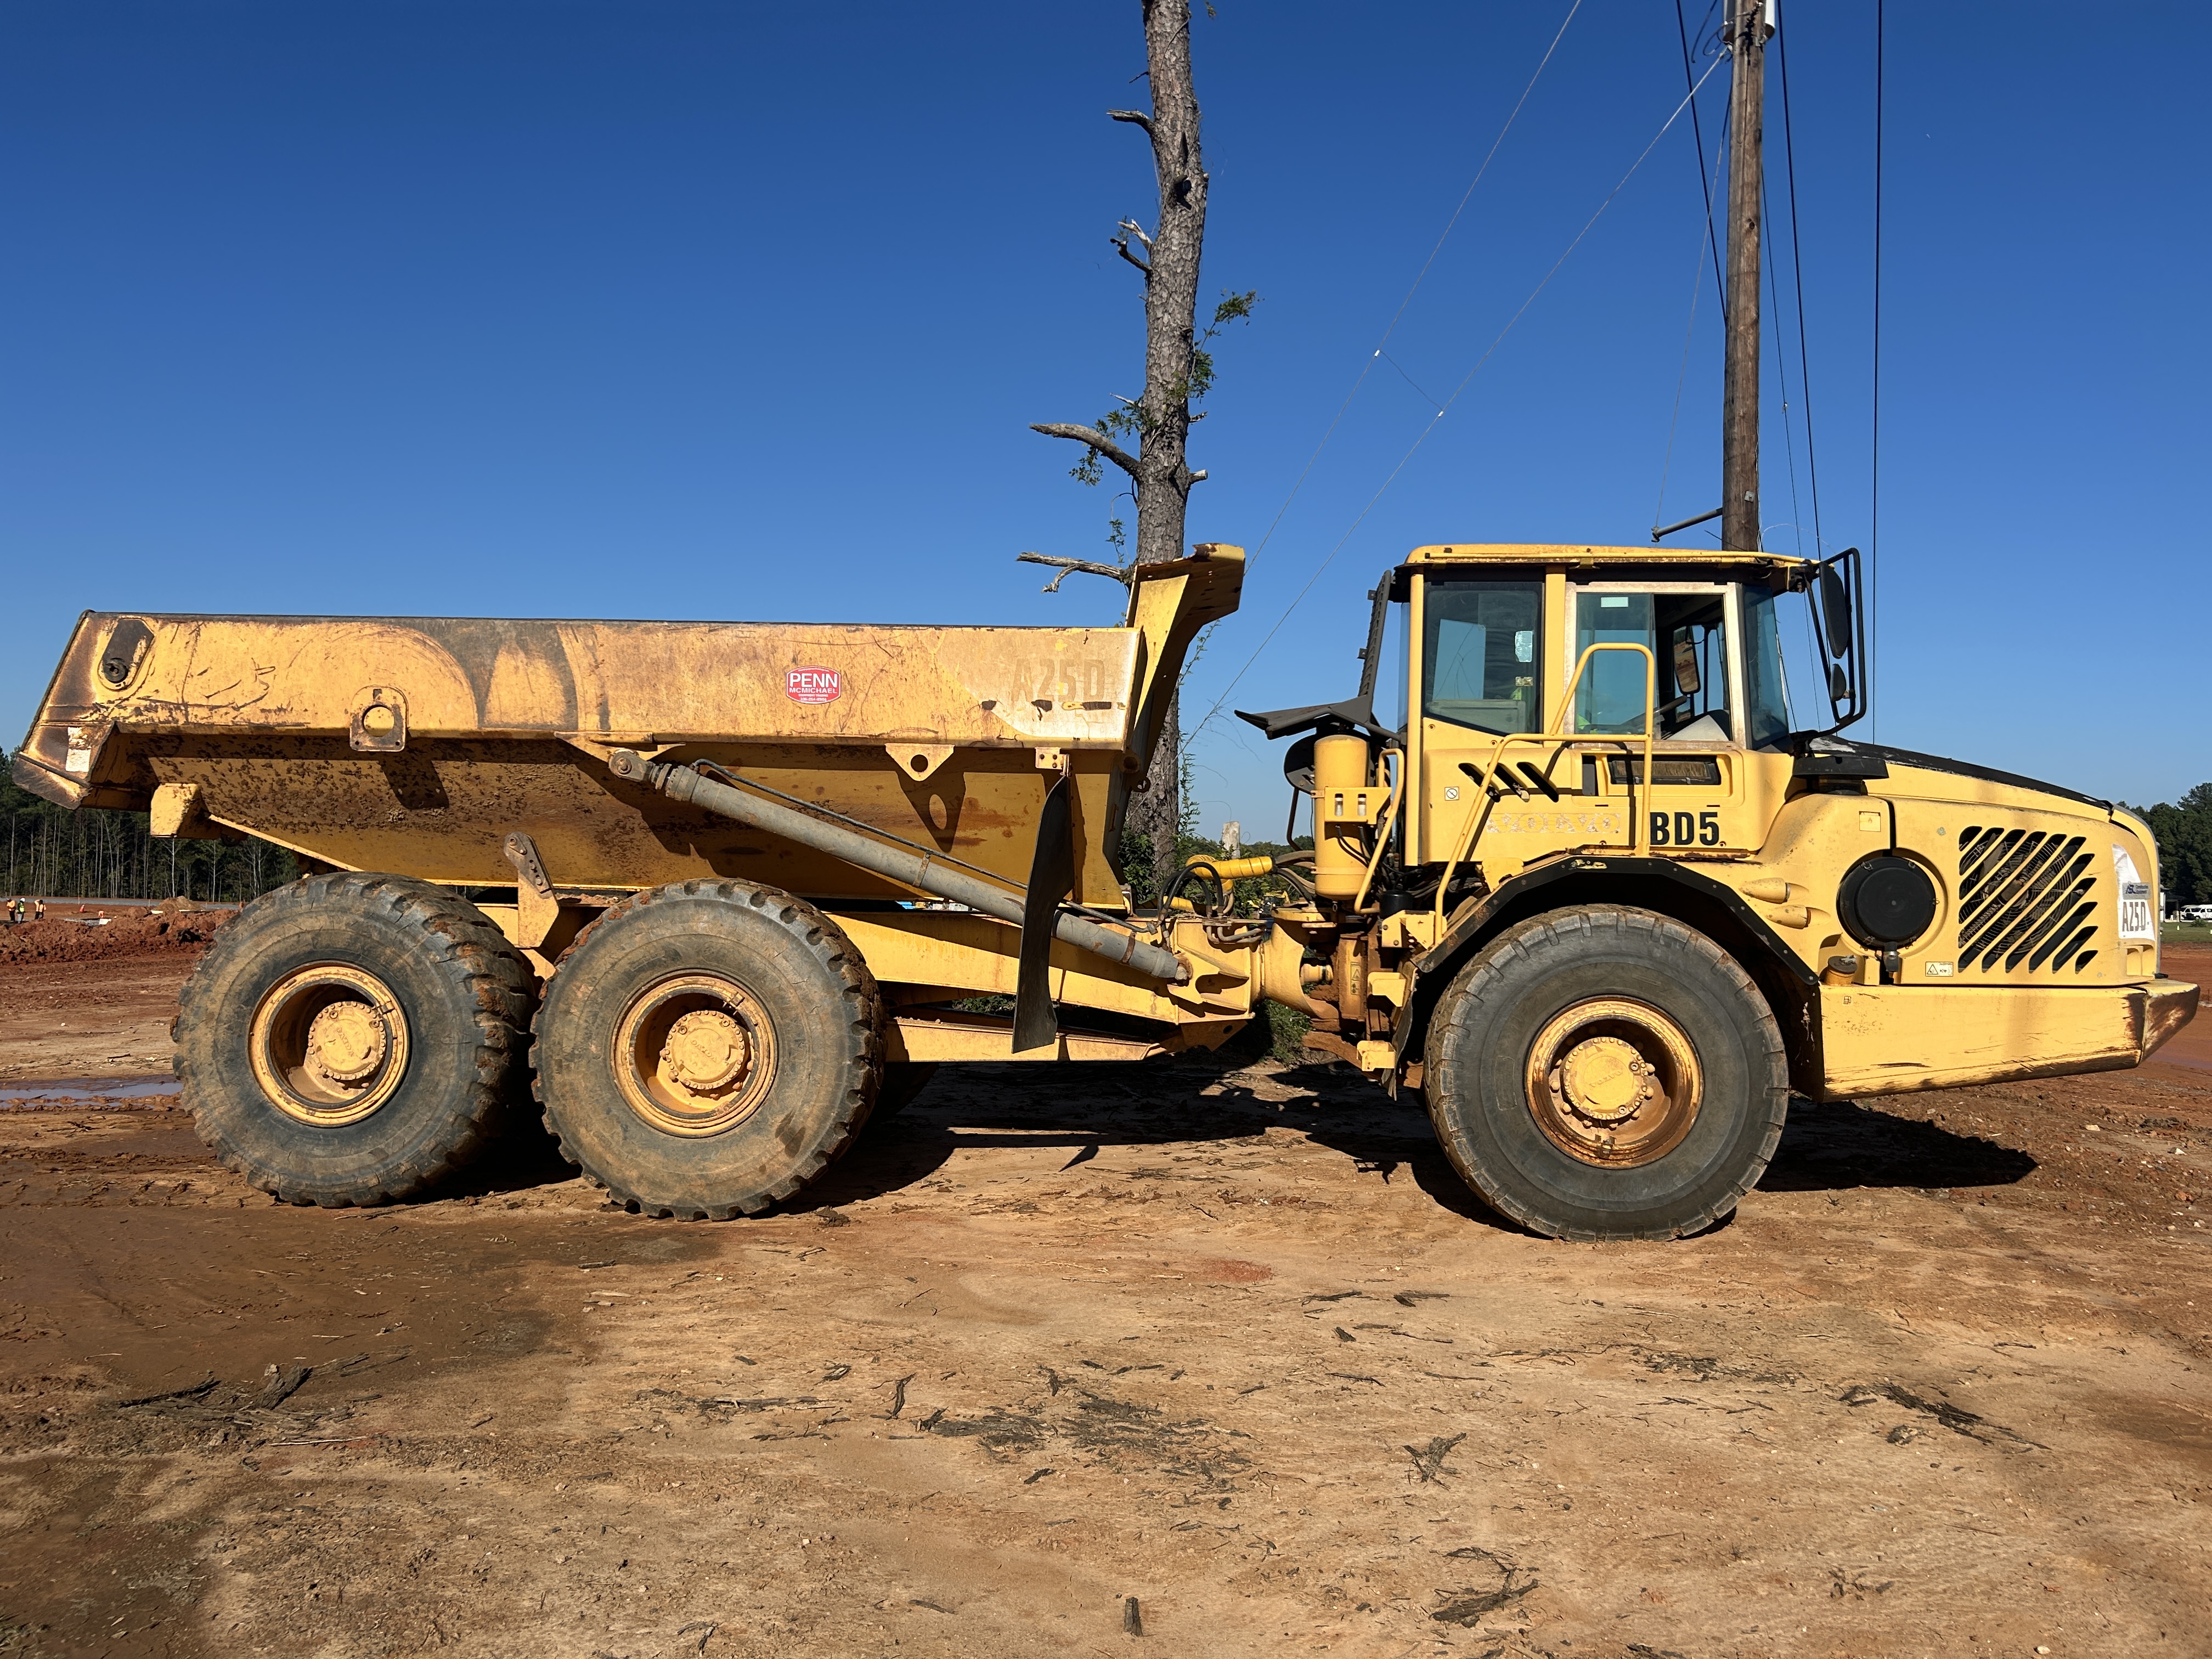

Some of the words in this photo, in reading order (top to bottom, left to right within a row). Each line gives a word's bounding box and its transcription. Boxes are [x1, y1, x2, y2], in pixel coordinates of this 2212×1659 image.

[789, 673, 838, 688] PENN
[1011, 658, 1105, 702] A25D
[1649, 811, 1720, 846] BD5
[2121, 901, 2146, 932] A25D
